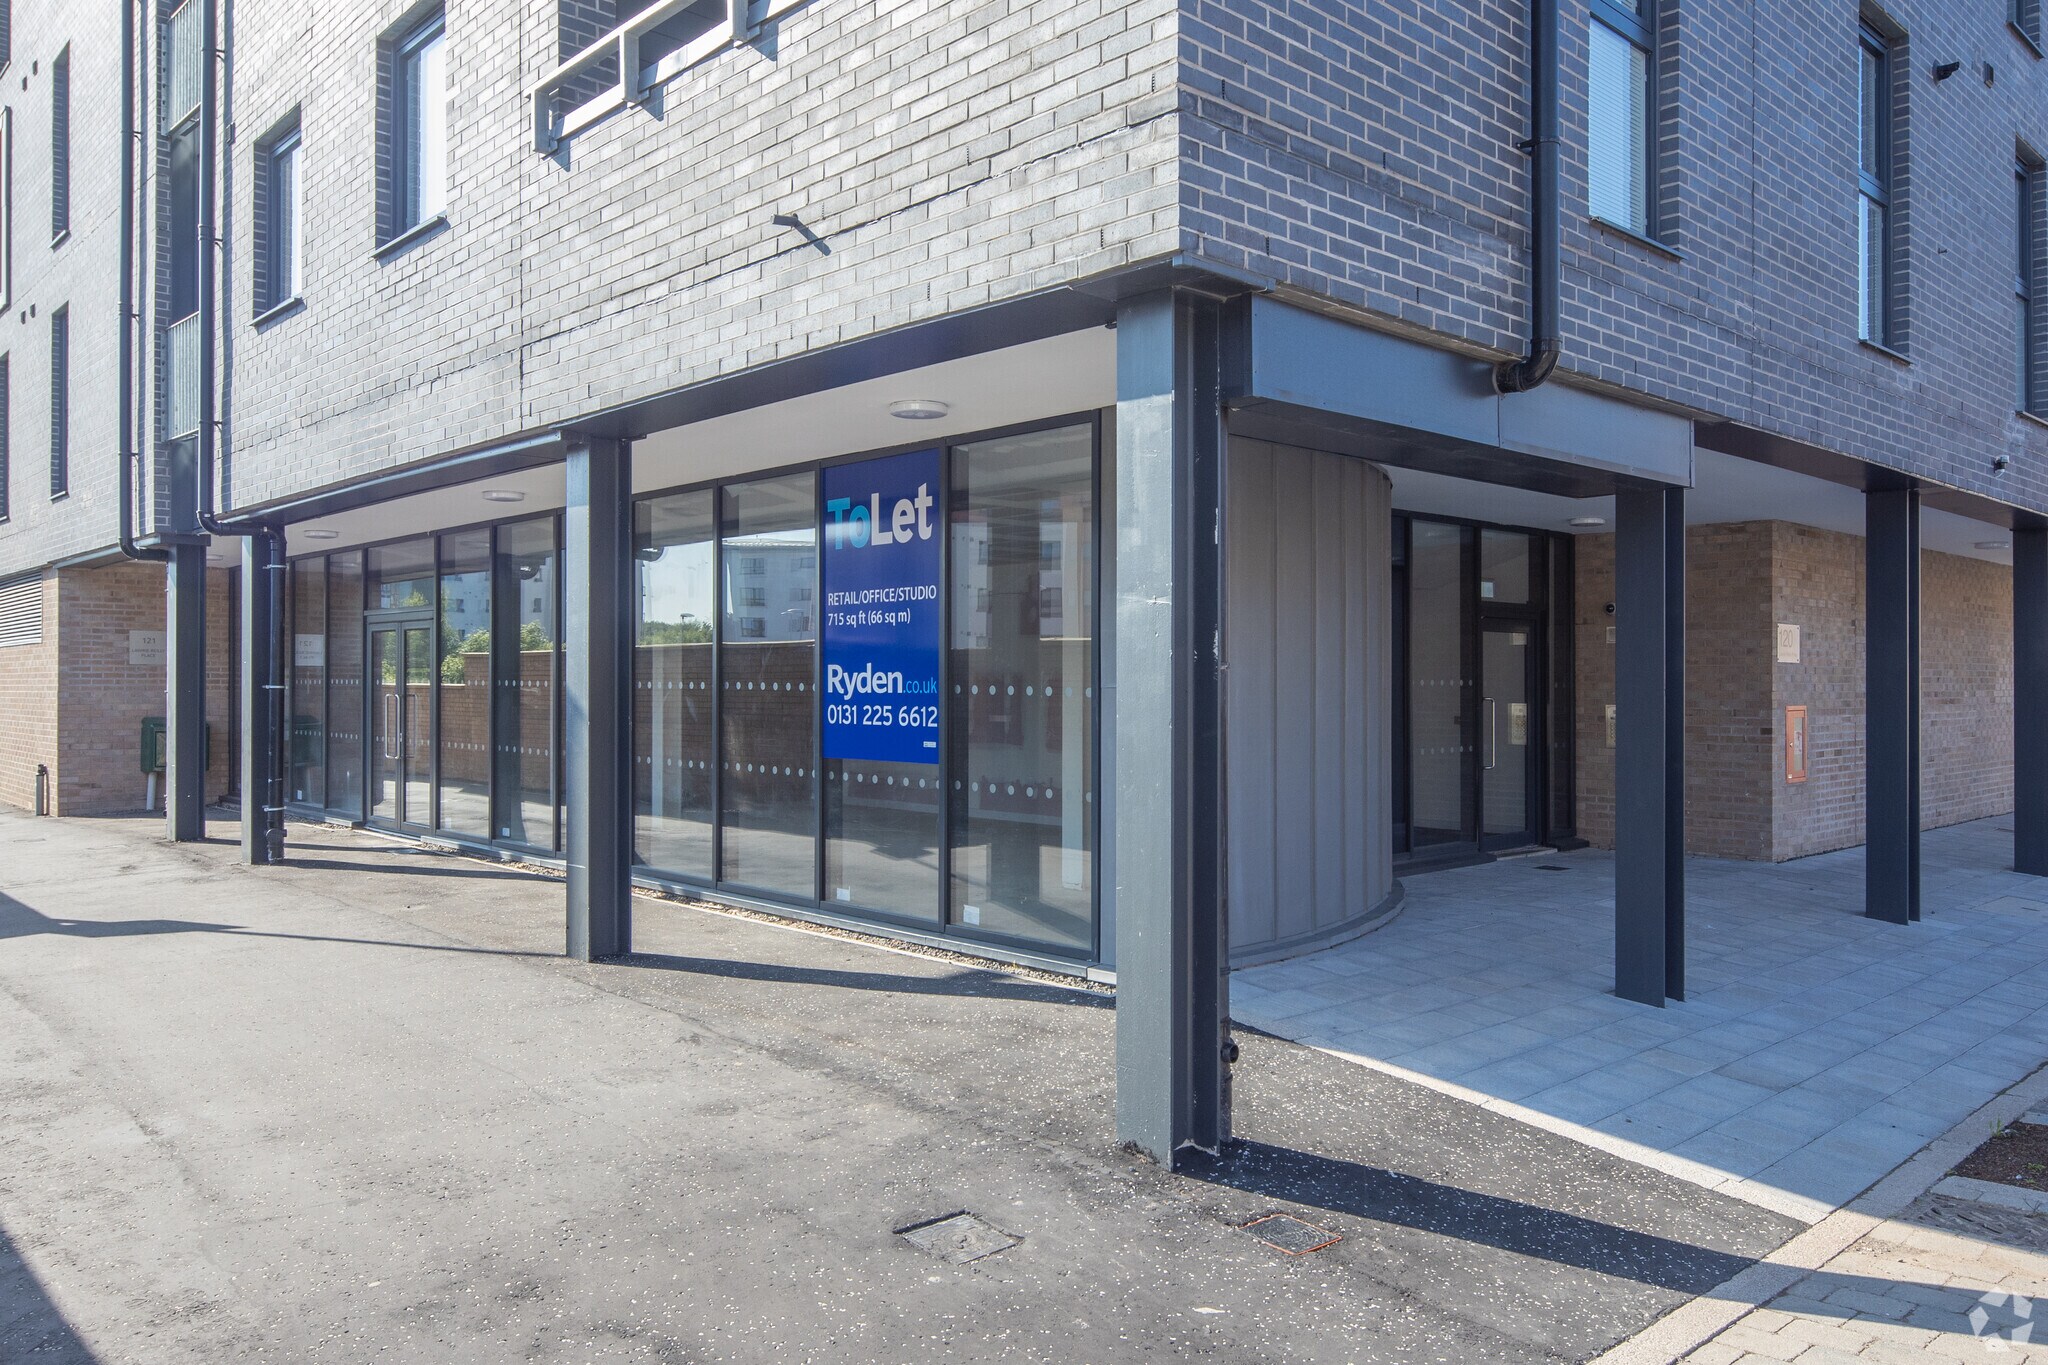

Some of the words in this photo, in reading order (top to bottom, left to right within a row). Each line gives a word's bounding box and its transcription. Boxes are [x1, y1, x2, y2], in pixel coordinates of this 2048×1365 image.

[827, 584, 938, 606] RETAIL/OFFICE/STUDIO
[828, 612, 845, 626] 715
[846, 613, 857, 629] sq
[858, 610, 866, 625] ft
[867, 610, 883, 626] (66
[884, 612, 895, 627] sq
[897, 608, 911, 624] m)
[1780, 629, 1794, 648] 120
[827, 662, 938, 701] Ryden.co.uk
[827, 704, 857, 725] 0131
[862, 704, 893, 727] 225
[898, 705, 938, 728] 6612
